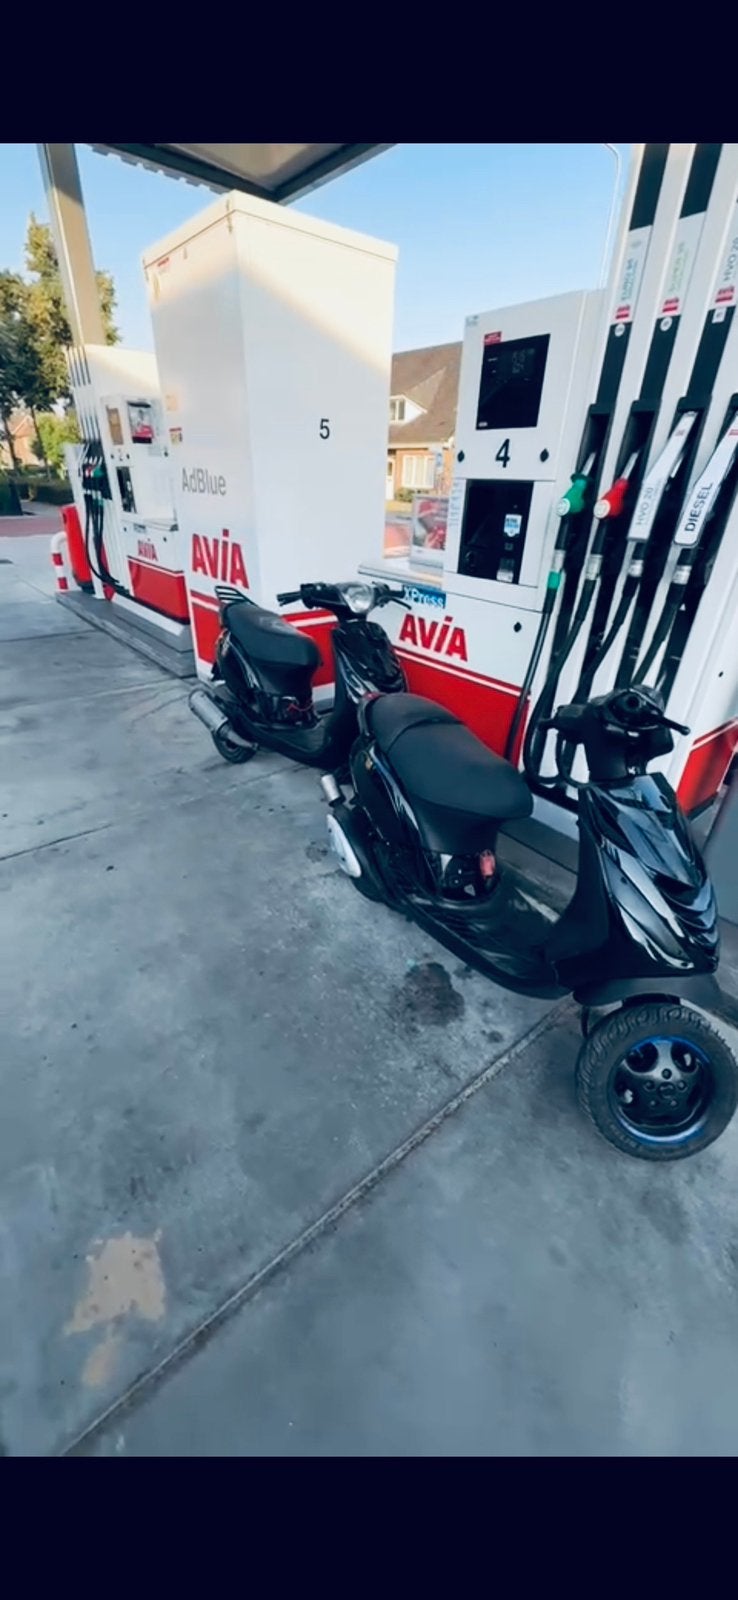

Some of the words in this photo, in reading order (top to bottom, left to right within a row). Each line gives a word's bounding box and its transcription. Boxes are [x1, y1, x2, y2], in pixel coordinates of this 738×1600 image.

[320, 418, 330, 440] 5
[495, 438, 510, 468] 4
[181, 467, 227, 496] AdBlue
[636, 503, 650, 526] HVO
[643, 487, 654, 499] 20
[684, 482, 713, 532] DIESEL
